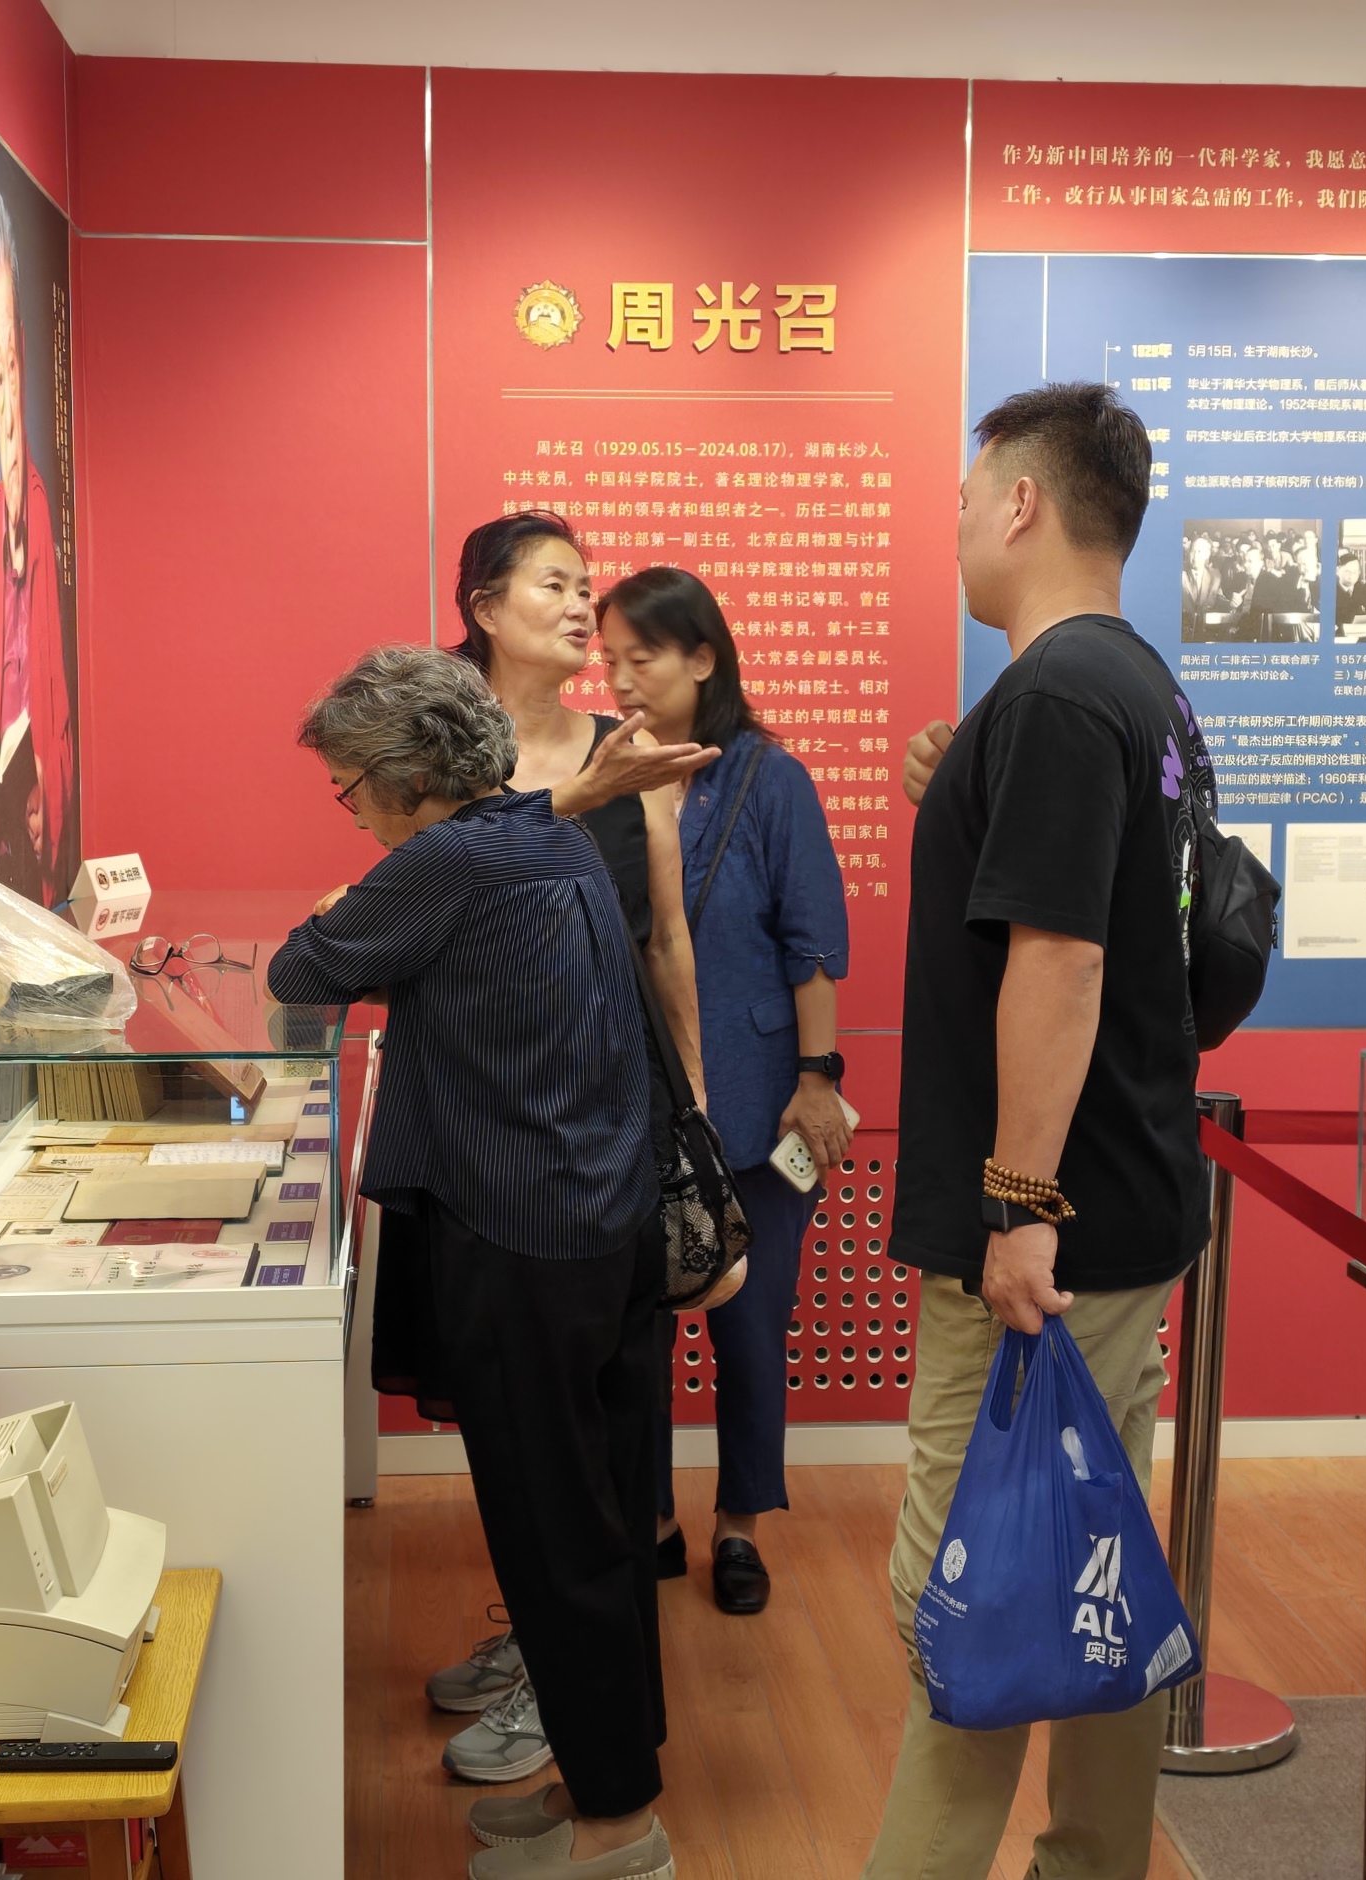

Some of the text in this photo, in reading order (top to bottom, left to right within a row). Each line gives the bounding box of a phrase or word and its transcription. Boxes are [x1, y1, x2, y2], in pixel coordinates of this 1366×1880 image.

[605, 281, 837, 353] 周光召
[503, 470, 892, 488] 中共党员，中国科学院院士，著名理论物理学家，我国
[1180, 670, 1296, 682] 核研究所参加学术讨论会。
[826, 795, 889, 811] 战略核武
